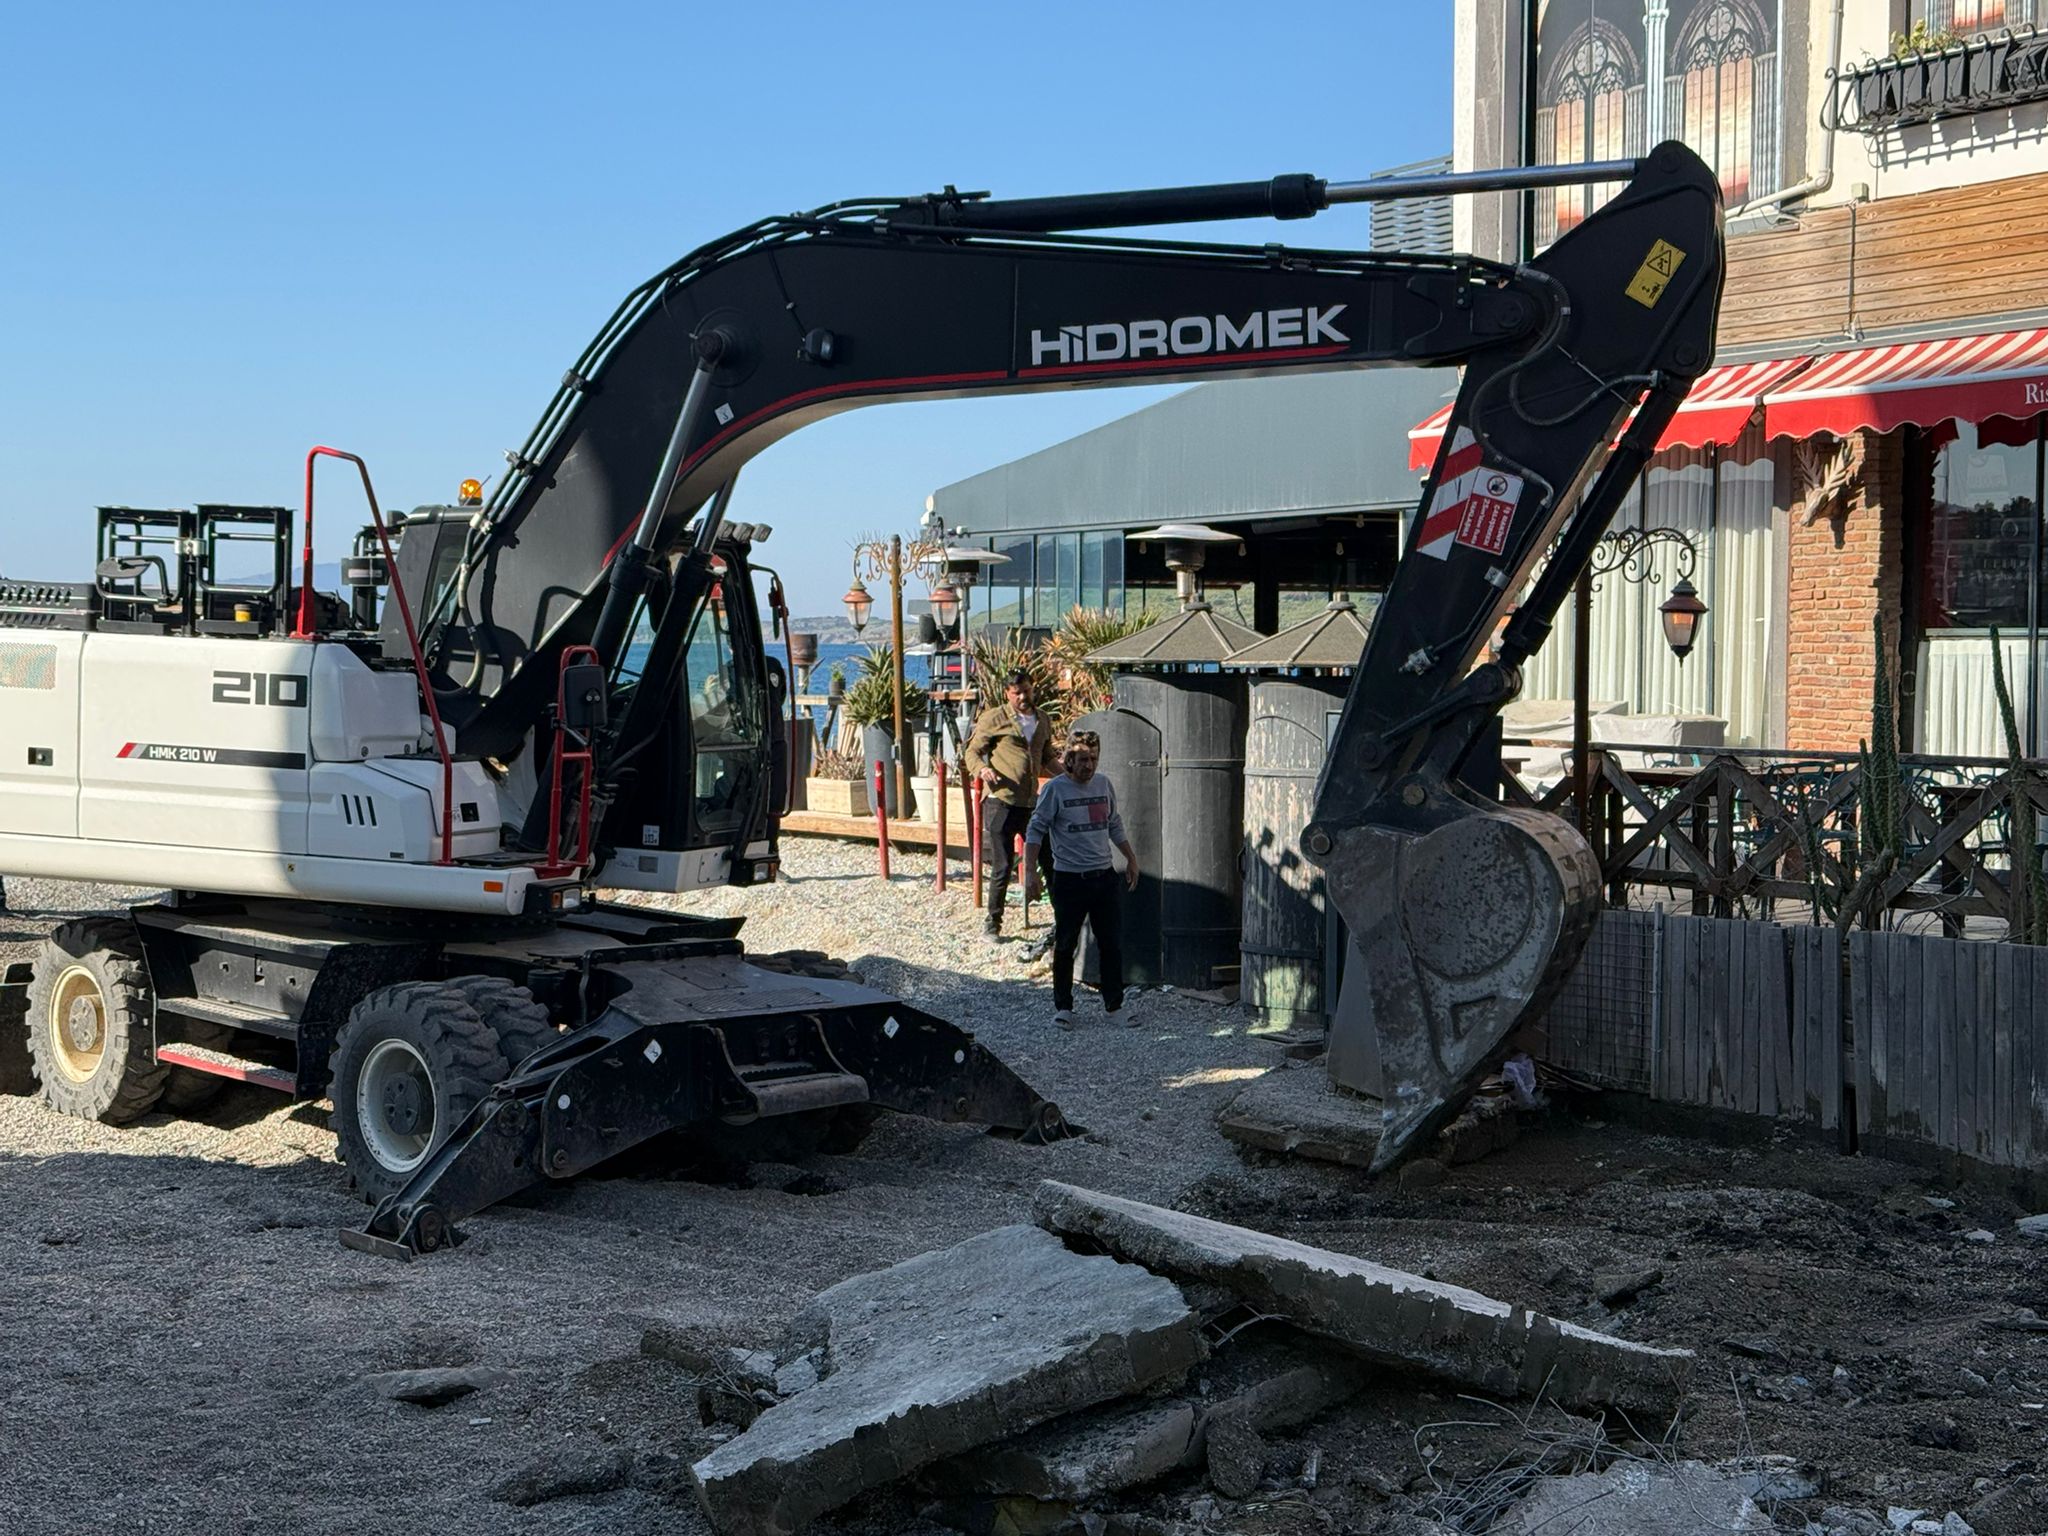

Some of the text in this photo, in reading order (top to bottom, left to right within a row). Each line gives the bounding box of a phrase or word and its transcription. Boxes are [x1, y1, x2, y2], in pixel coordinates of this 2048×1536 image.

[212, 670, 308, 707] 210
[149, 746, 217, 762] HMK 210 W
